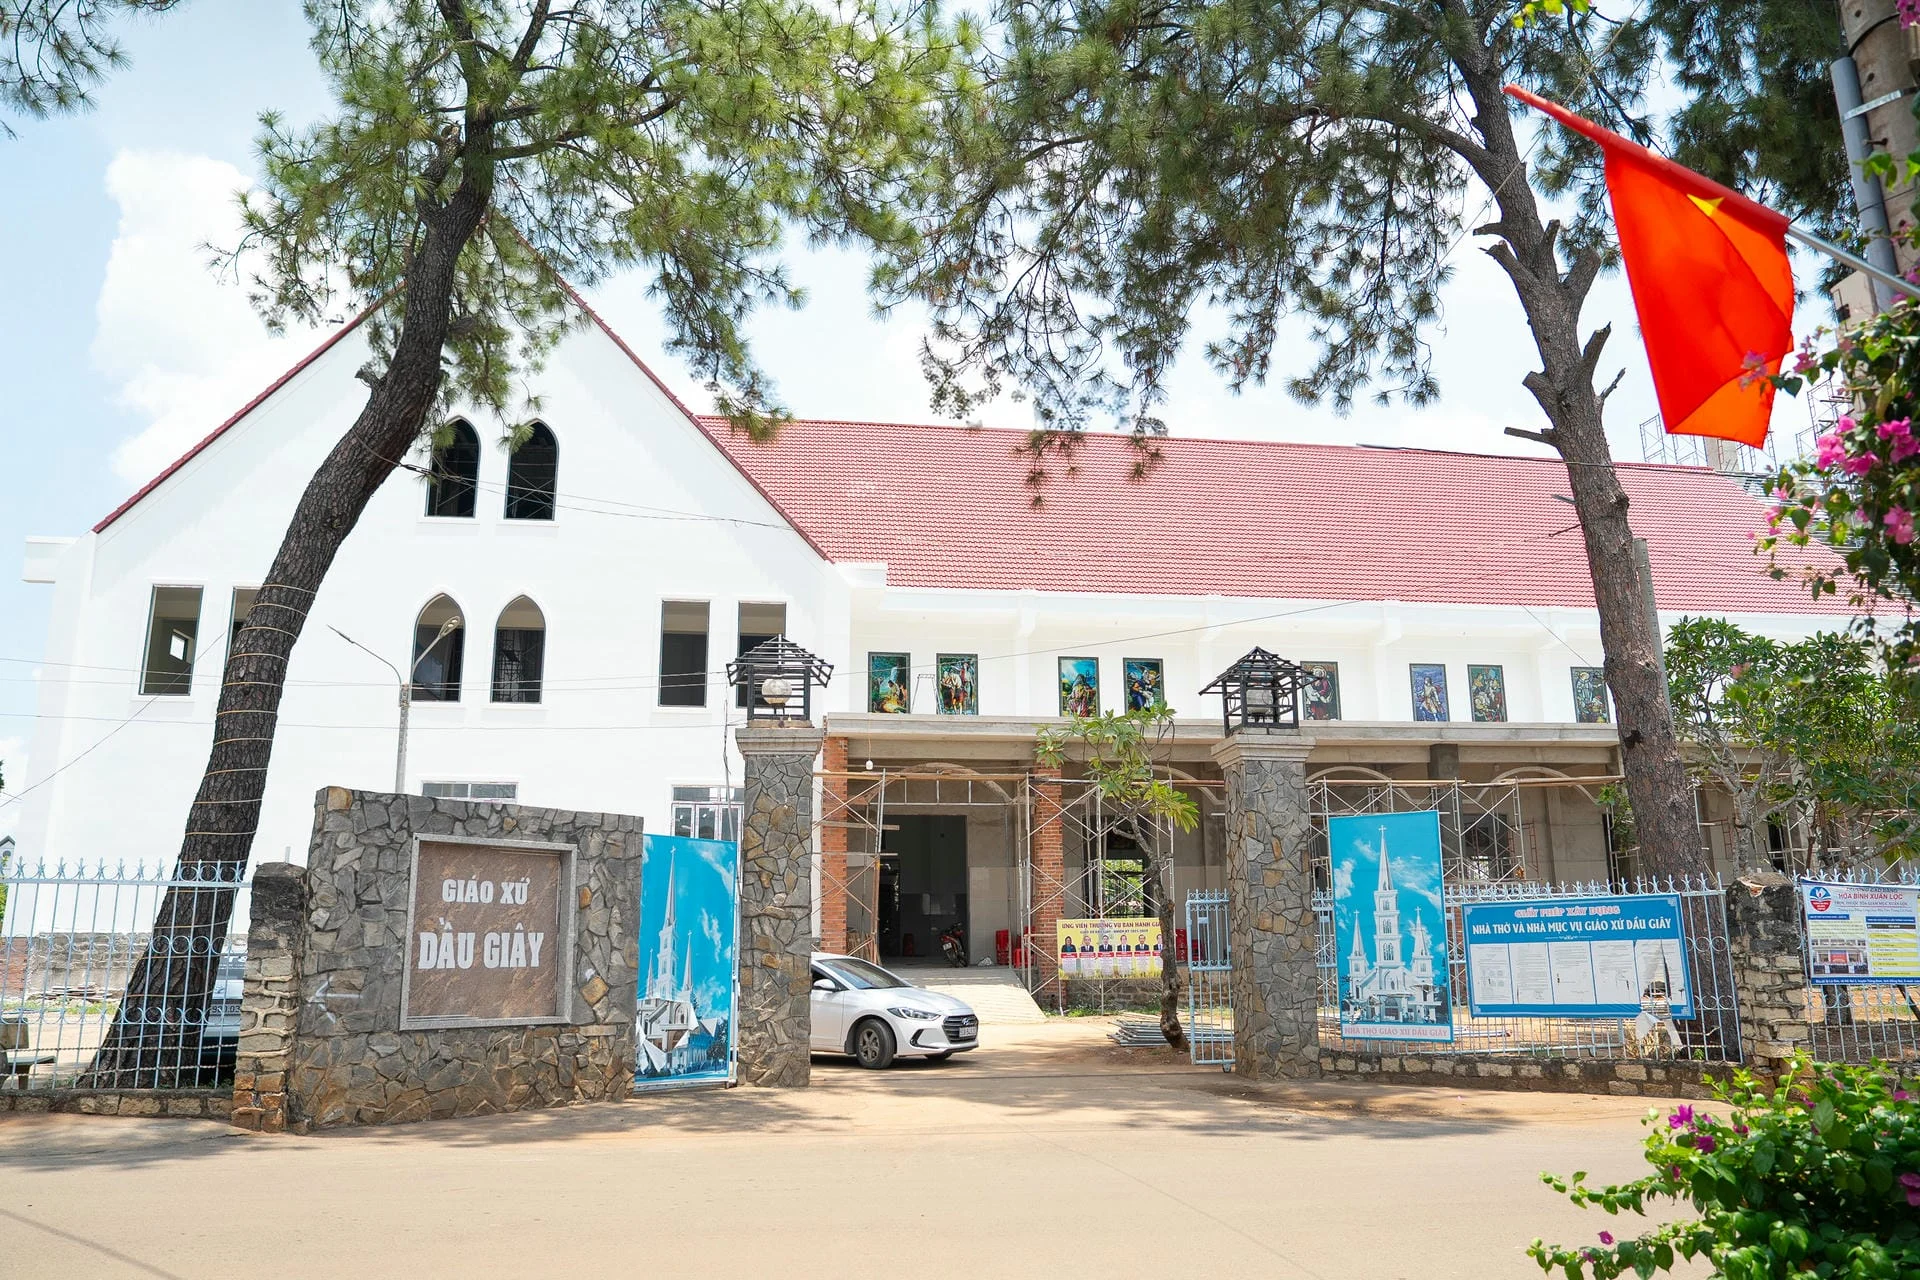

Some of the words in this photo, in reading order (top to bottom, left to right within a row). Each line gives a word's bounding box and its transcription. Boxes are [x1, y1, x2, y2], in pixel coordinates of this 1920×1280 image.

[442, 875, 494, 904] GIÁO
[500, 877, 531, 905] XỨ
[1472, 922, 1492, 936] NHÀ
[1494, 922, 1512, 934] THỜ
[1512, 922, 1526, 934] VÀ
[1526, 920, 1546, 934] NHÀ
[1548, 922, 1568, 934] MỤC
[1570, 922, 1582, 934] VỤ
[1584, 920, 1610, 932] GIÁO
[1610, 918, 1626, 930] XỨ
[1648, 916, 1672, 930] GIÂY
[418, 917, 476, 970] DẦU
[483, 922, 544, 969] GIÂY
